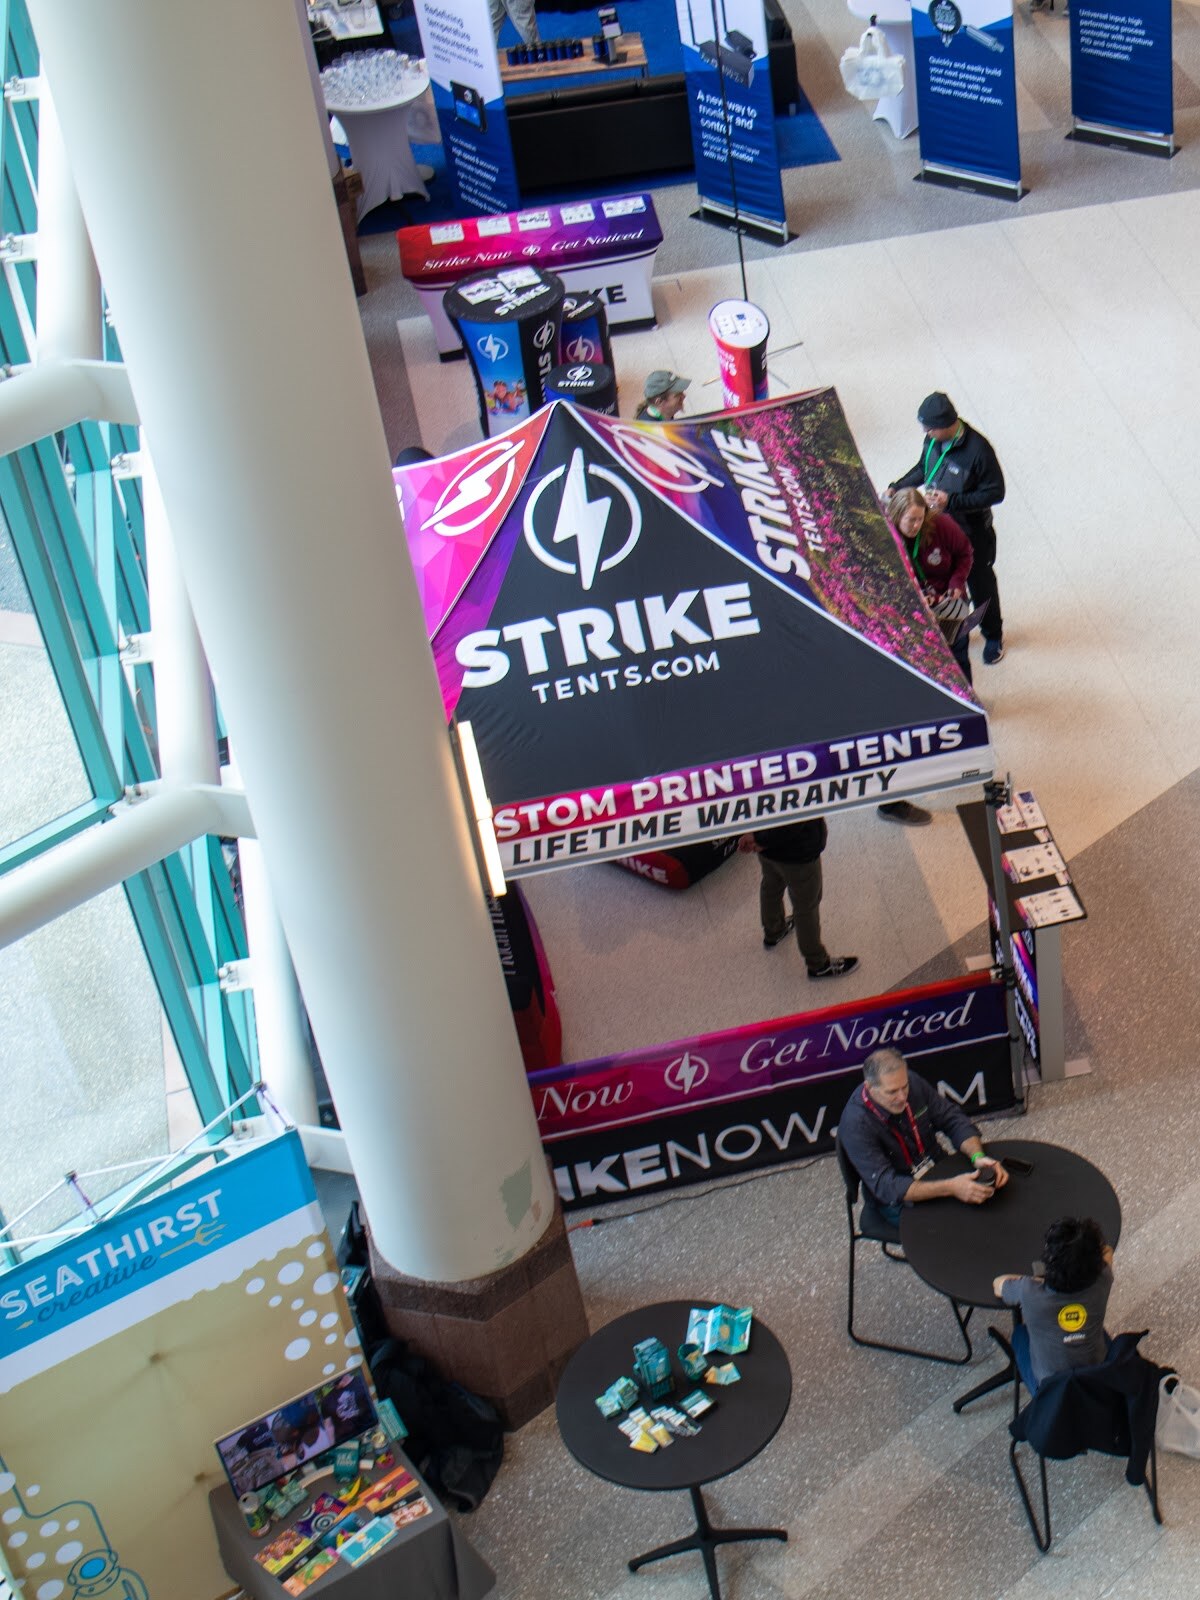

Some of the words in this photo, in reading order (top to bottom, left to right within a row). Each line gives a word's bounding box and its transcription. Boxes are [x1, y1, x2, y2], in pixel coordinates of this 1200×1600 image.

[1079, 9, 1108, 20] Universal
[1128, 16, 1142, 27] high
[1080, 20, 1120, 32] performance
[1121, 25, 1145, 36] process
[1093, 40, 1105, 48] and
[1111, 33, 1124, 41] with
[929, 55, 953, 69] Quickly
[954, 61, 966, 70] and
[966, 63, 985, 74] easily
[985, 66, 1002, 77] build
[929, 67, 944, 75] your
[944, 69, 958, 78] next
[959, 72, 986, 83] pressure
[930, 75, 966, 89] instruments
[967, 82, 980, 92] with
[930, 85, 952, 96] unique
[952, 89, 979, 100] modular
[697, 89, 705, 102] A
[726, 101, 746, 117] way
[747, 105, 757, 119] to
[735, 116, 754, 130] and
[421, 258, 470, 271] Strike
[473, 250, 513, 264] Now
[551, 239, 579, 252] Get
[583, 228, 644, 248] Noticed
[710, 429, 811, 581] STRIKE
[455, 582, 761, 688] STRIKE
[531, 651, 721, 704] TENTS.COM
[631, 750, 817, 810] PRINTED
[829, 722, 965, 771] TENTS
[513, 811, 683, 866] LIFETIME
[696, 768, 898, 829] WARRANTY
[537, 1080, 634, 1120] Now
[739, 1036, 813, 1074] Get
[822, 991, 976, 1058] Noticed
[0, 1188, 222, 1320] SEATHIRST
[37, 1255, 157, 1322] creative
